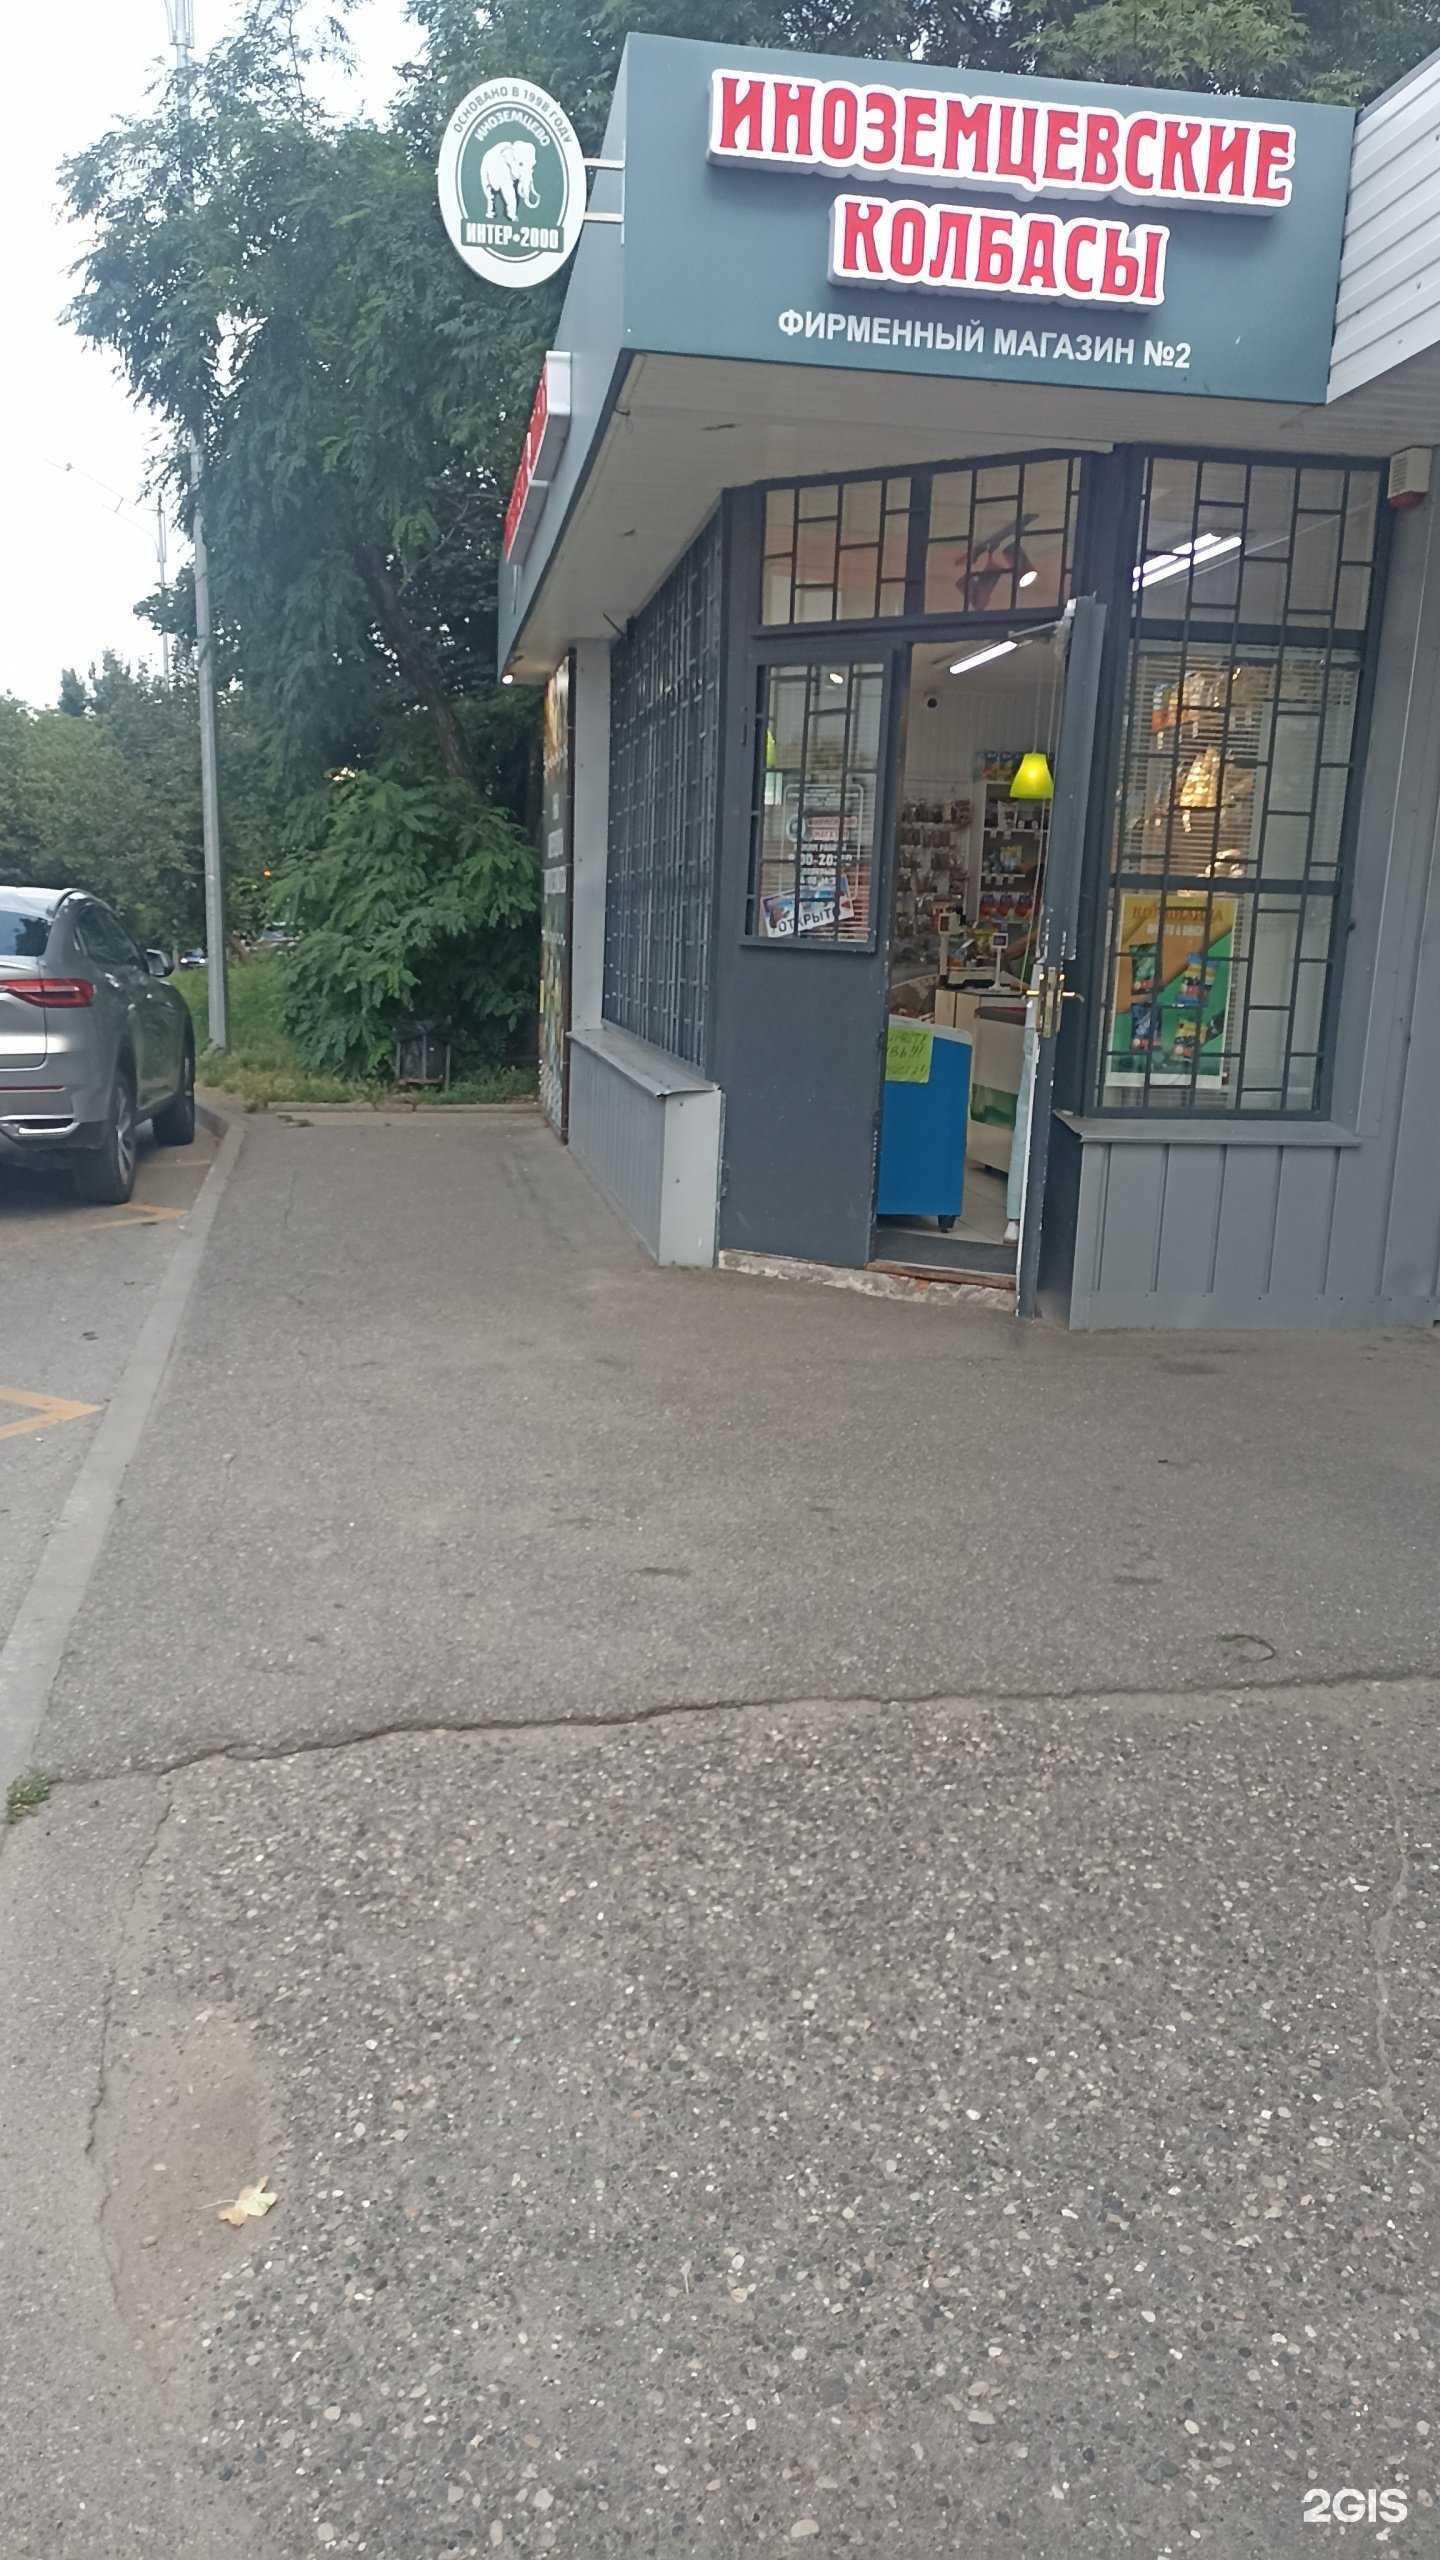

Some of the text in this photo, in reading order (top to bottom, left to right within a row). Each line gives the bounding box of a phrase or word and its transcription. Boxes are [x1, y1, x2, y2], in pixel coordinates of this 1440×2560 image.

[453, 86, 508, 133] ОСНОВАНО
[512, 87, 520, 97] В
[549, 111, 573, 143] ГОДУ
[474, 110, 551, 147] ИНОЗЕМЦЕВО
[720, 78, 1290, 199] ИНОЗЕМЦЕВСКИЕ
[843, 202, 1161, 299] КОЛБАСЫ
[777, 308, 1192, 369] ФИРМЕННЫЙ МАГАЗИН №2
[778, 905, 842, 932] ОТРЫТ
